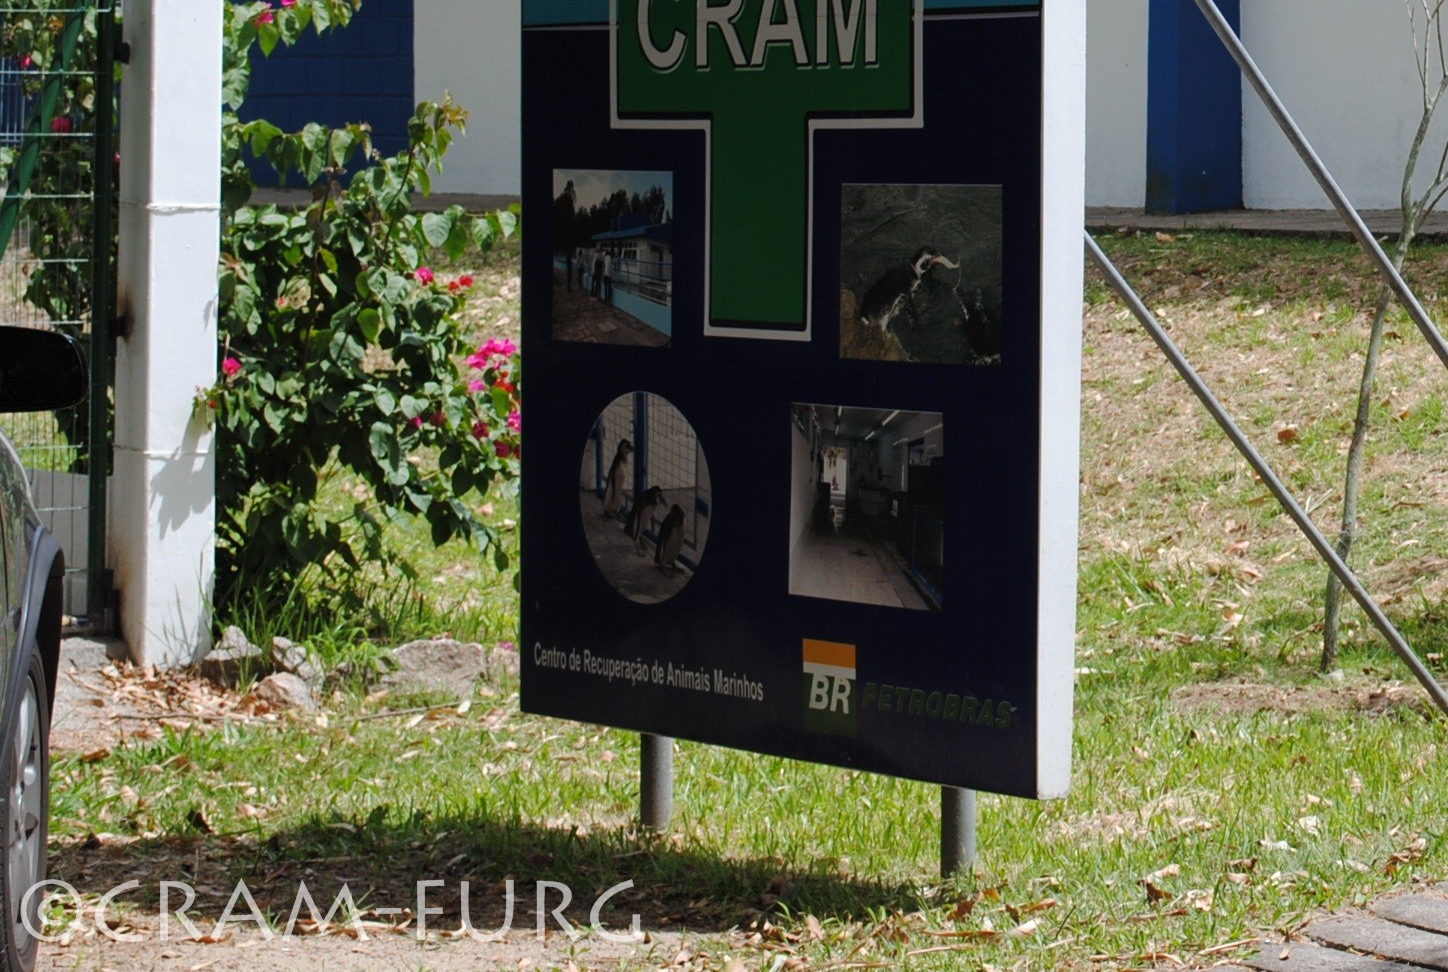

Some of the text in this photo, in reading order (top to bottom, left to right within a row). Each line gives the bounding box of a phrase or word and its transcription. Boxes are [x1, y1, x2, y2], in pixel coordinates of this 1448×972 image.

[534, 641, 764, 702] Centro de Recuperação de Animais Marinhos
[808, 674, 851, 715] BR
[862, 681, 1017, 727] PETROBRAS
